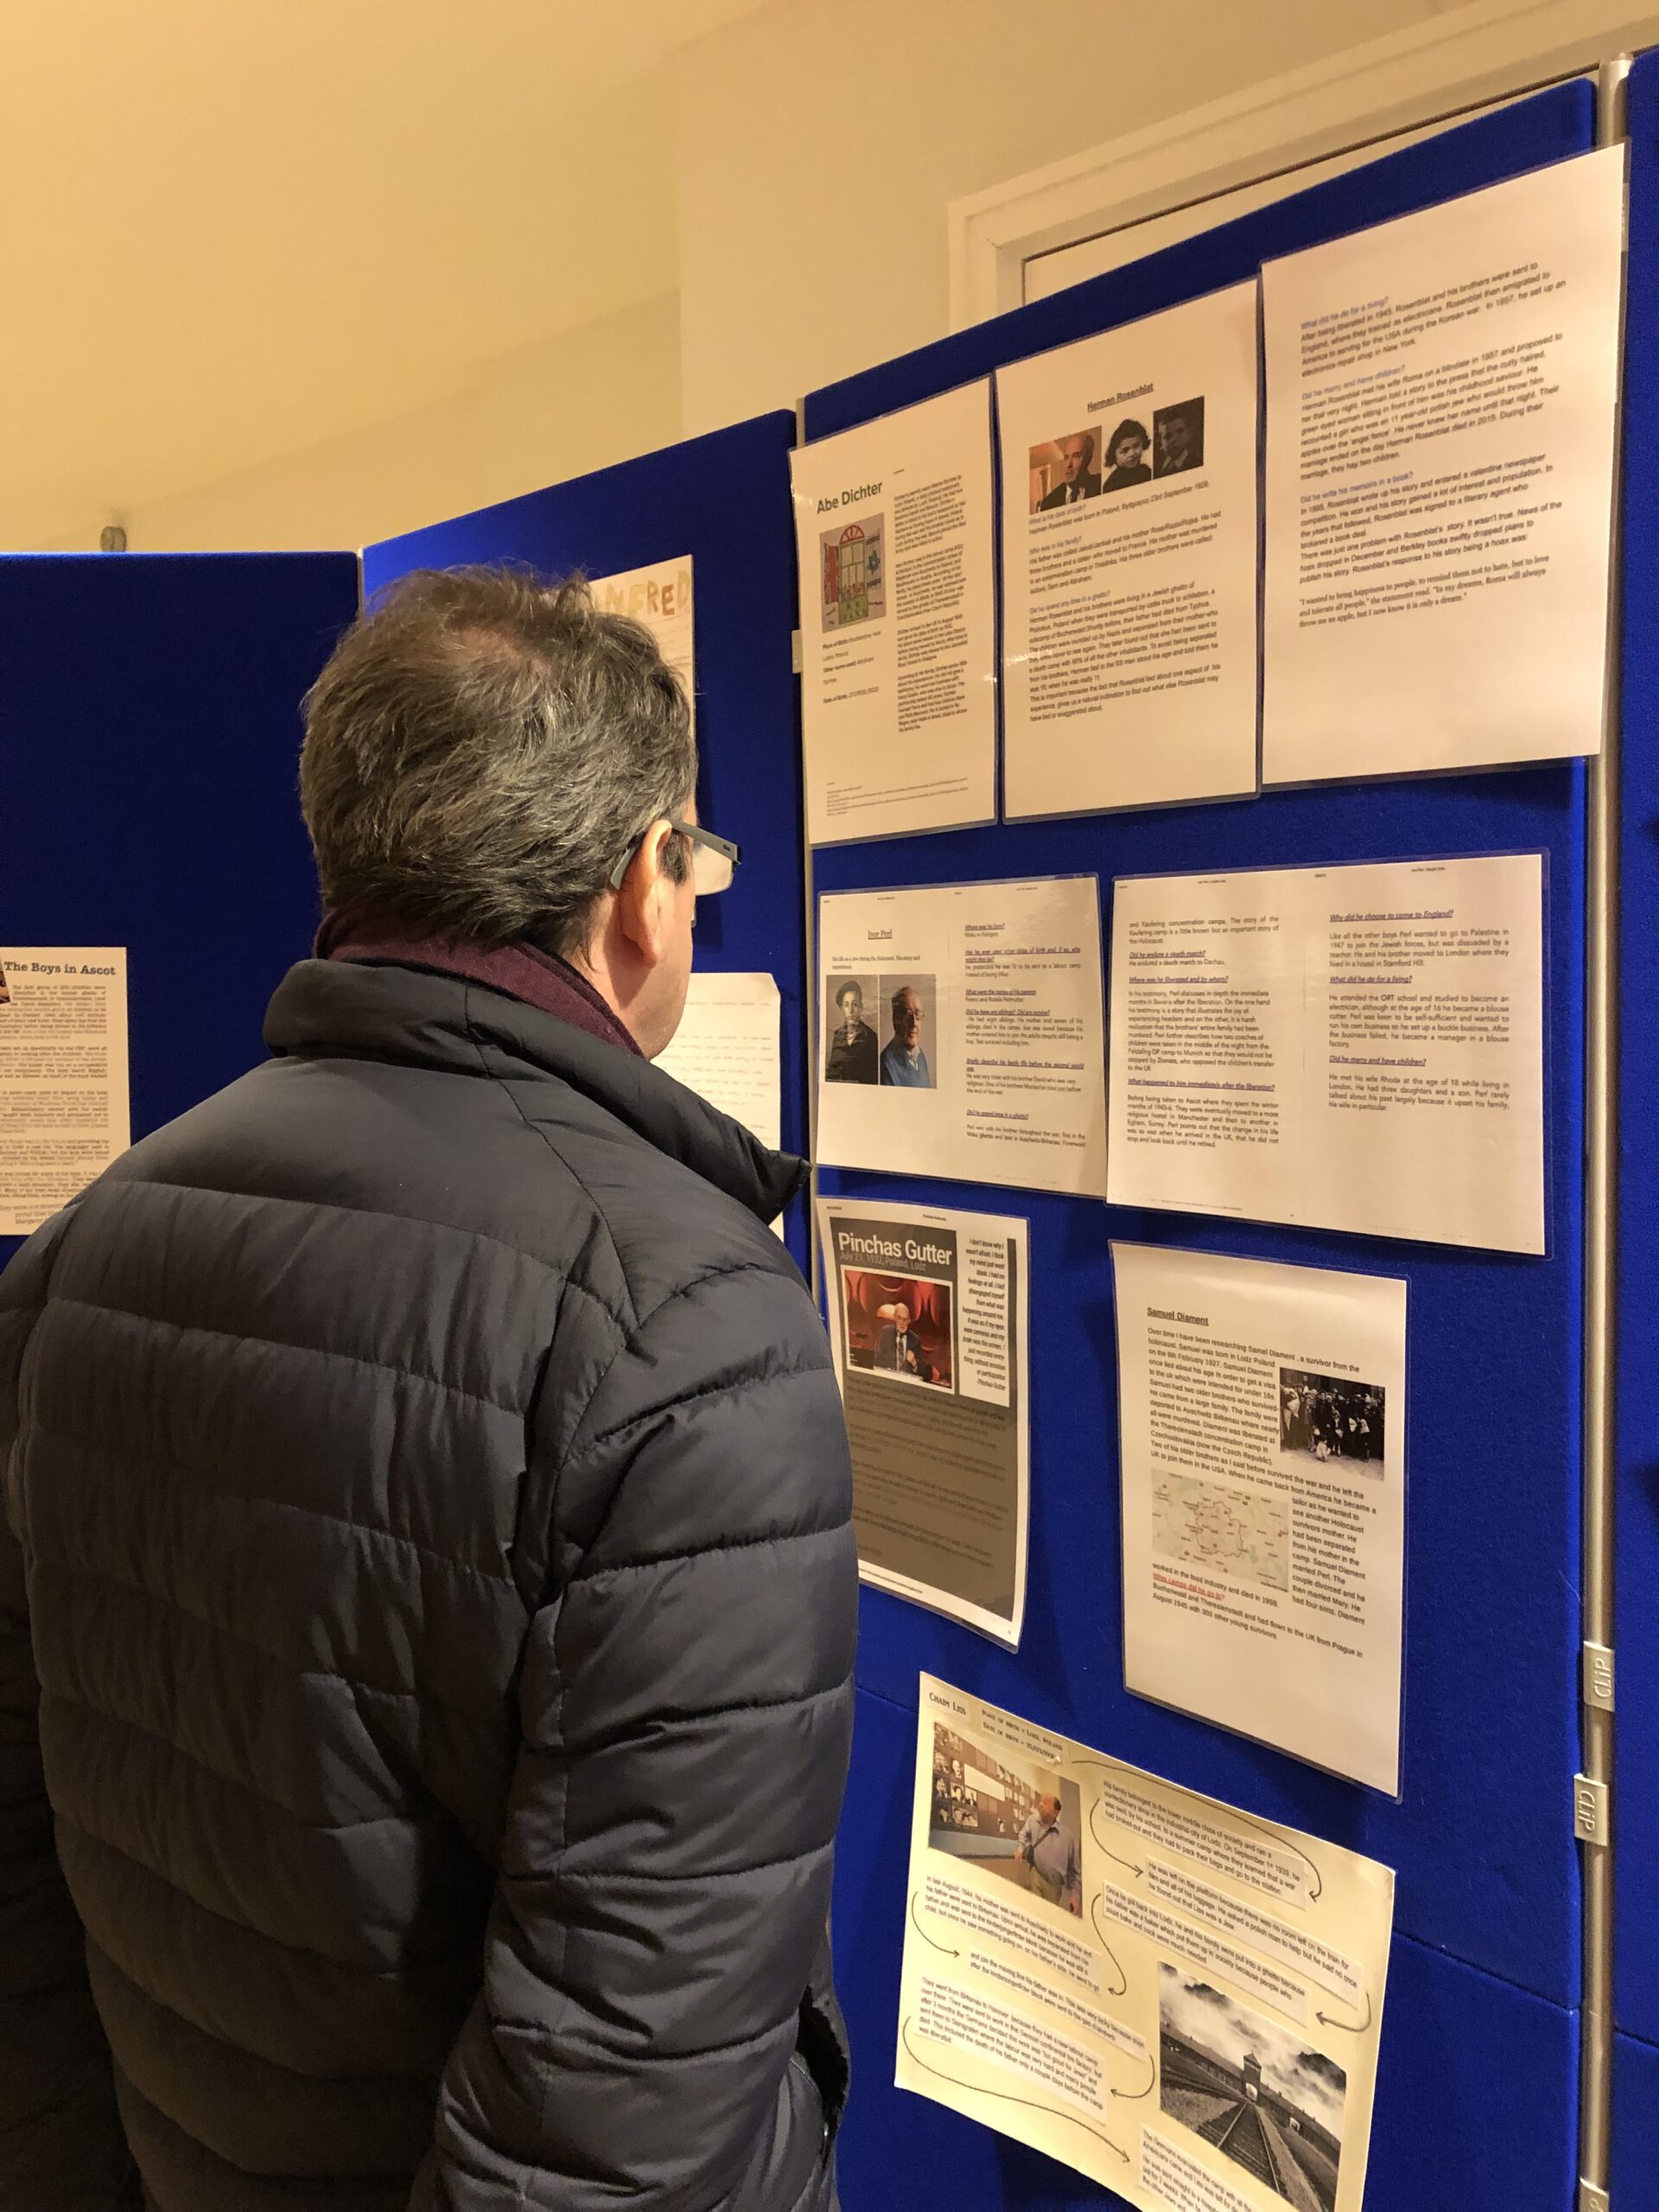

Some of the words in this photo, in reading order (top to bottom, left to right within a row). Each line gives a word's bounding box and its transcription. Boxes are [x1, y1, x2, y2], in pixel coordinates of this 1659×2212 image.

[1087, 396, 1115, 412] Herman
[1117, 384, 1154, 402] Rosenblat
[817, 499, 839, 514] Abe
[842, 482, 882, 505] Dichter
[868, 930, 879, 939] Ivor
[881, 930, 892, 939] Perl
[1355, 941, 1367, 950] join
[1403, 940, 1424, 949] forces,
[1494, 949, 1509, 957] they
[3, 962, 28, 971] The
[32, 963, 60, 974] Boys
[65, 964, 77, 973] in
[80, 965, 116, 975] Ascot
[838, 1232, 902, 1257] Pinchas
[906, 1240, 952, 1265] Gutter
[1147, 1307, 1175, 1320] Samuel
[1176, 1313, 1209, 1326] Diament
[1147, 1328, 1161, 1337] Over
[1162, 1331, 1175, 1339] time
[1179, 1333, 1194, 1343] have
[1194, 1336, 1210, 1345] been
[1211, 1341, 1247, 1353] researching
[1268, 1350, 1295, 1361] Diament
[1306, 1357, 1331, 1368] survivor
[1332, 1361, 1348, 1370] from
[1348, 1364, 1360, 1373] the
[1293, 1497, 1307, 1507] tailor
[1327, 1508, 1351, 1519] wanted
[1293, 1531, 1305, 1541] had
[1305, 1535, 1322, 1545] been
[1323, 1541, 1356, 1554] separated
[1293, 1541, 1306, 1552] from
[1306, 1546, 1317, 1554] his
[1318, 1550, 1340, 1561] mother
[1348, 1558, 1360, 1567] the
